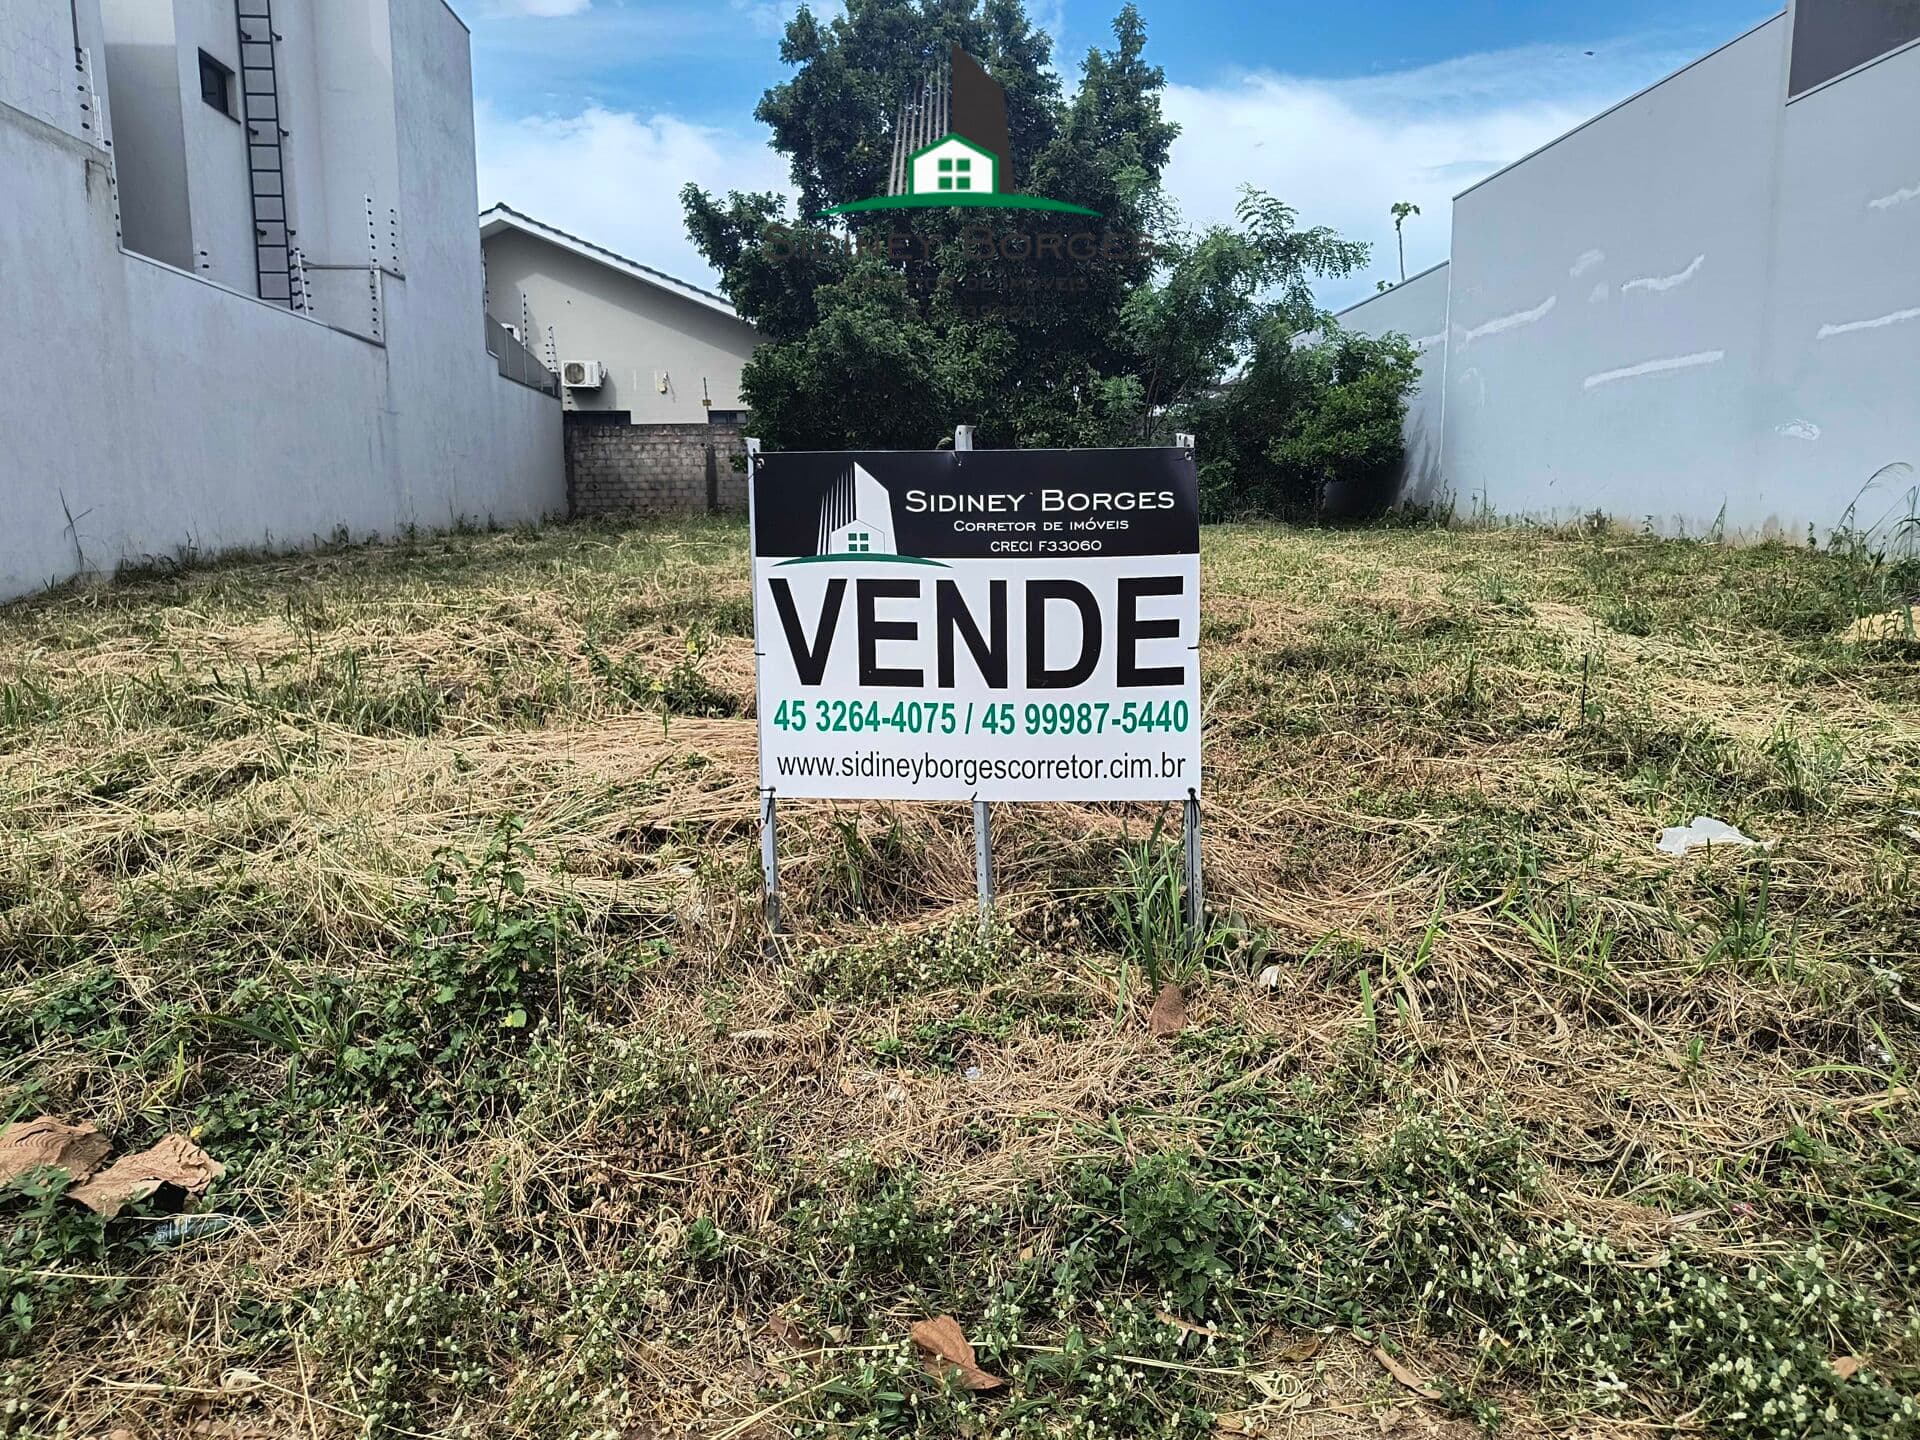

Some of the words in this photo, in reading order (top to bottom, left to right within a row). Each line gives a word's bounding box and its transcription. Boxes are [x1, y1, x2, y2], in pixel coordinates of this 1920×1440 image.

[905, 490, 1026, 513] SIDINEY
[1041, 489, 1175, 512] BORGES
[953, 520, 1037, 532] CORRETOR
[1043, 521, 1064, 532] DE
[1069, 516, 1130, 531] IMÓVEIS
[990, 541, 1033, 553] CRECI
[1038, 540, 1102, 552] F33060
[767, 575, 1186, 690] VENDE
[773, 699, 807, 732] 45
[815, 700, 957, 735] 3264-4075
[964, 702, 974, 735] /
[981, 702, 1016, 735] 45
[1024, 699, 1189, 735] 99987-5440
[776, 750, 1187, 786] www.sidineyborgescorretor.cim.br
